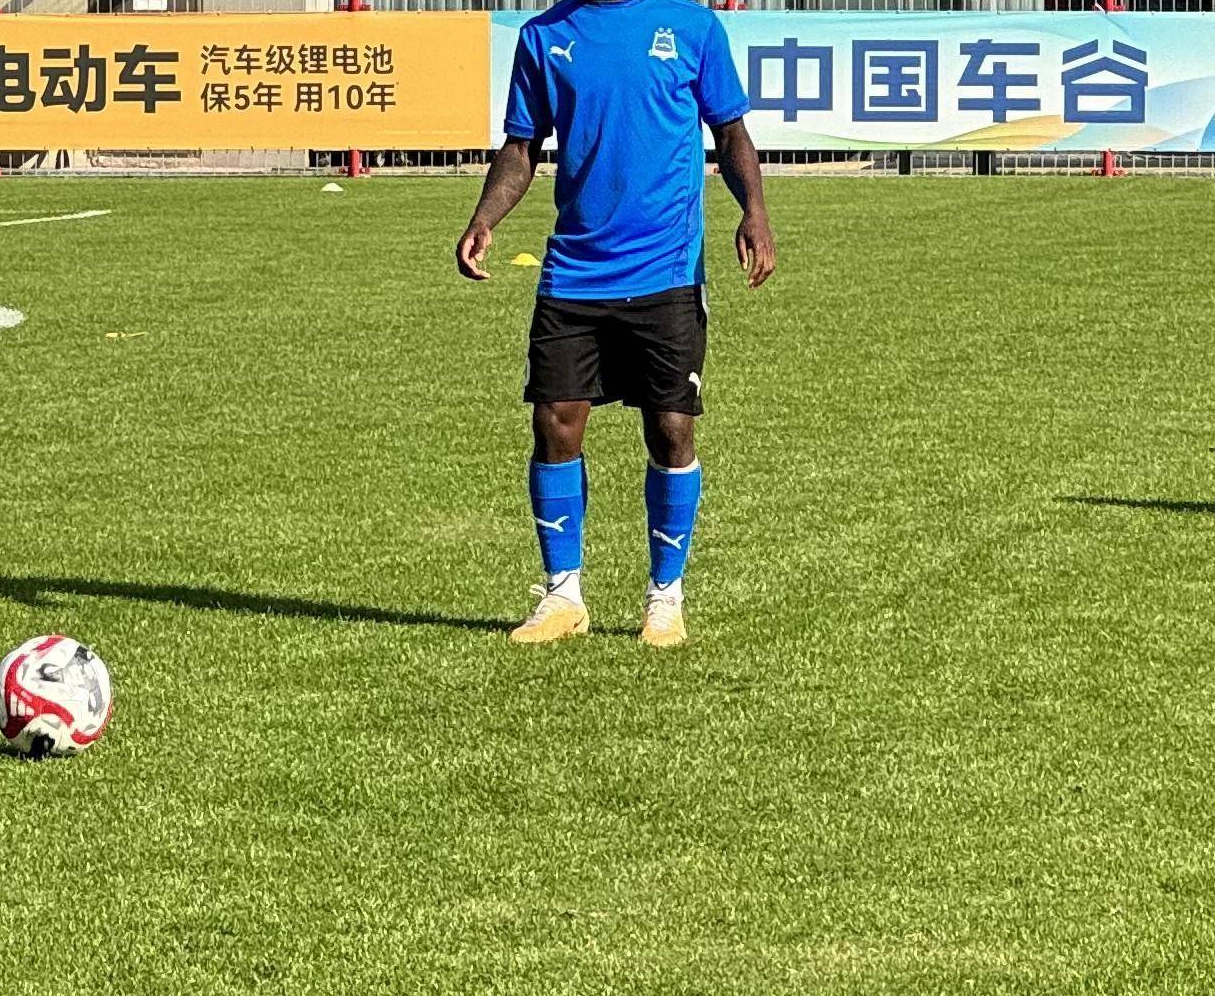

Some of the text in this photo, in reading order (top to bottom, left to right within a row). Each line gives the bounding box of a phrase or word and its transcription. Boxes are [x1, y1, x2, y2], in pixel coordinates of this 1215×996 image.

[200, 44, 395, 75] 汽车级锂电池
[747, 37, 1149, 124] 中国车谷
[200, 81, 397, 113] 保5年 用10年
